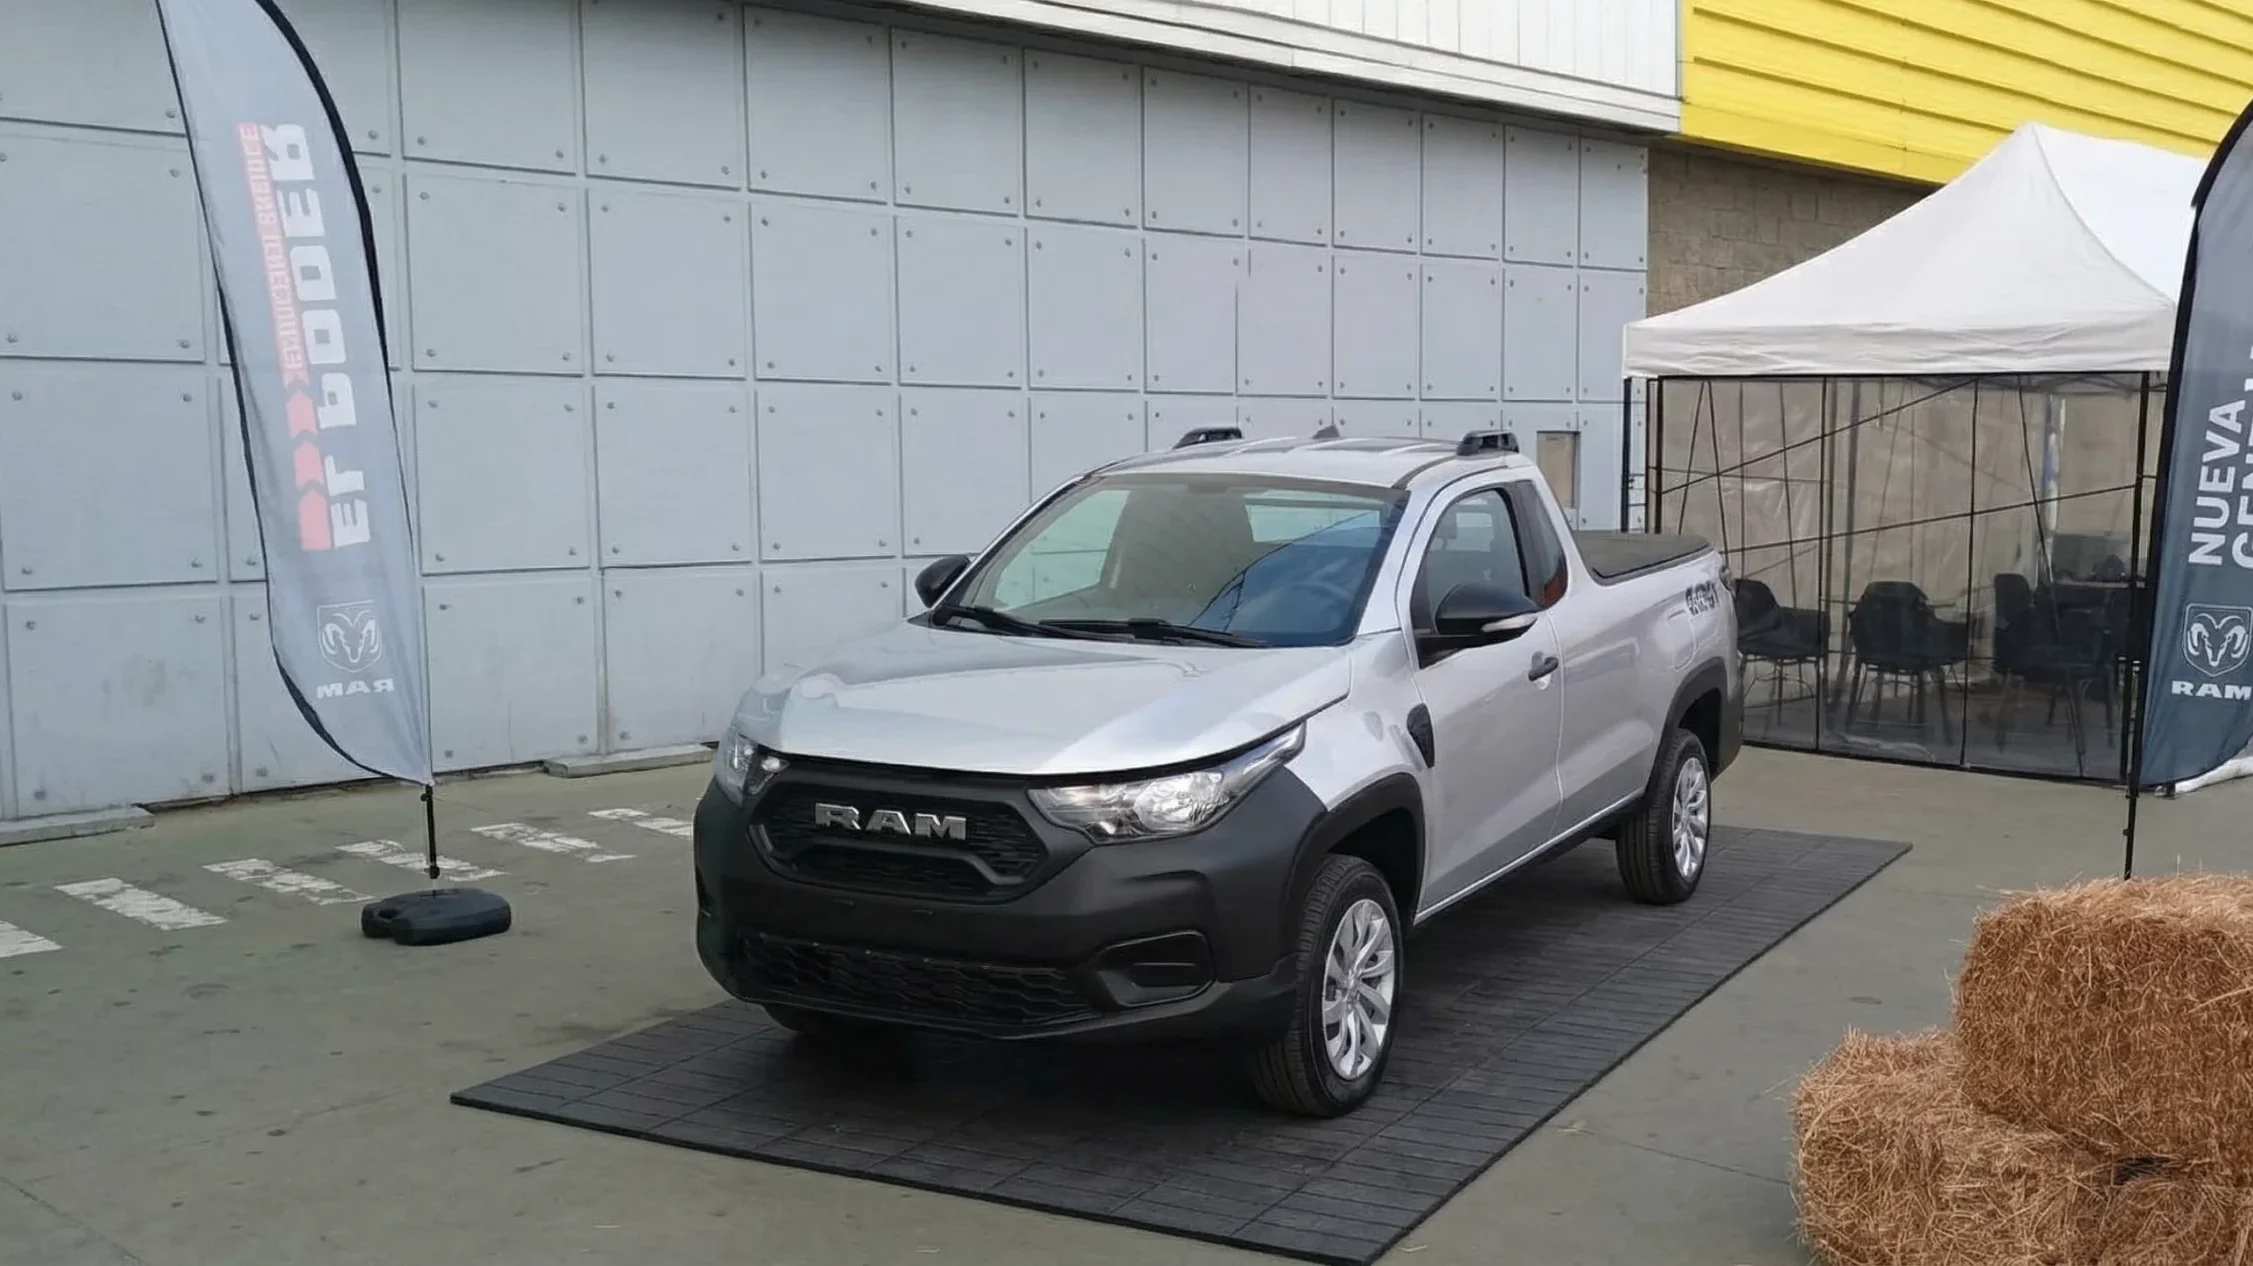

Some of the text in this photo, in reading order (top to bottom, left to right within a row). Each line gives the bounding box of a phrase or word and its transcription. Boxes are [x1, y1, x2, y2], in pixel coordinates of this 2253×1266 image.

[2188, 399, 2246, 566] NUEVA
[2171, 680, 2252, 700] RAM
[815, 802, 967, 841] RAM
